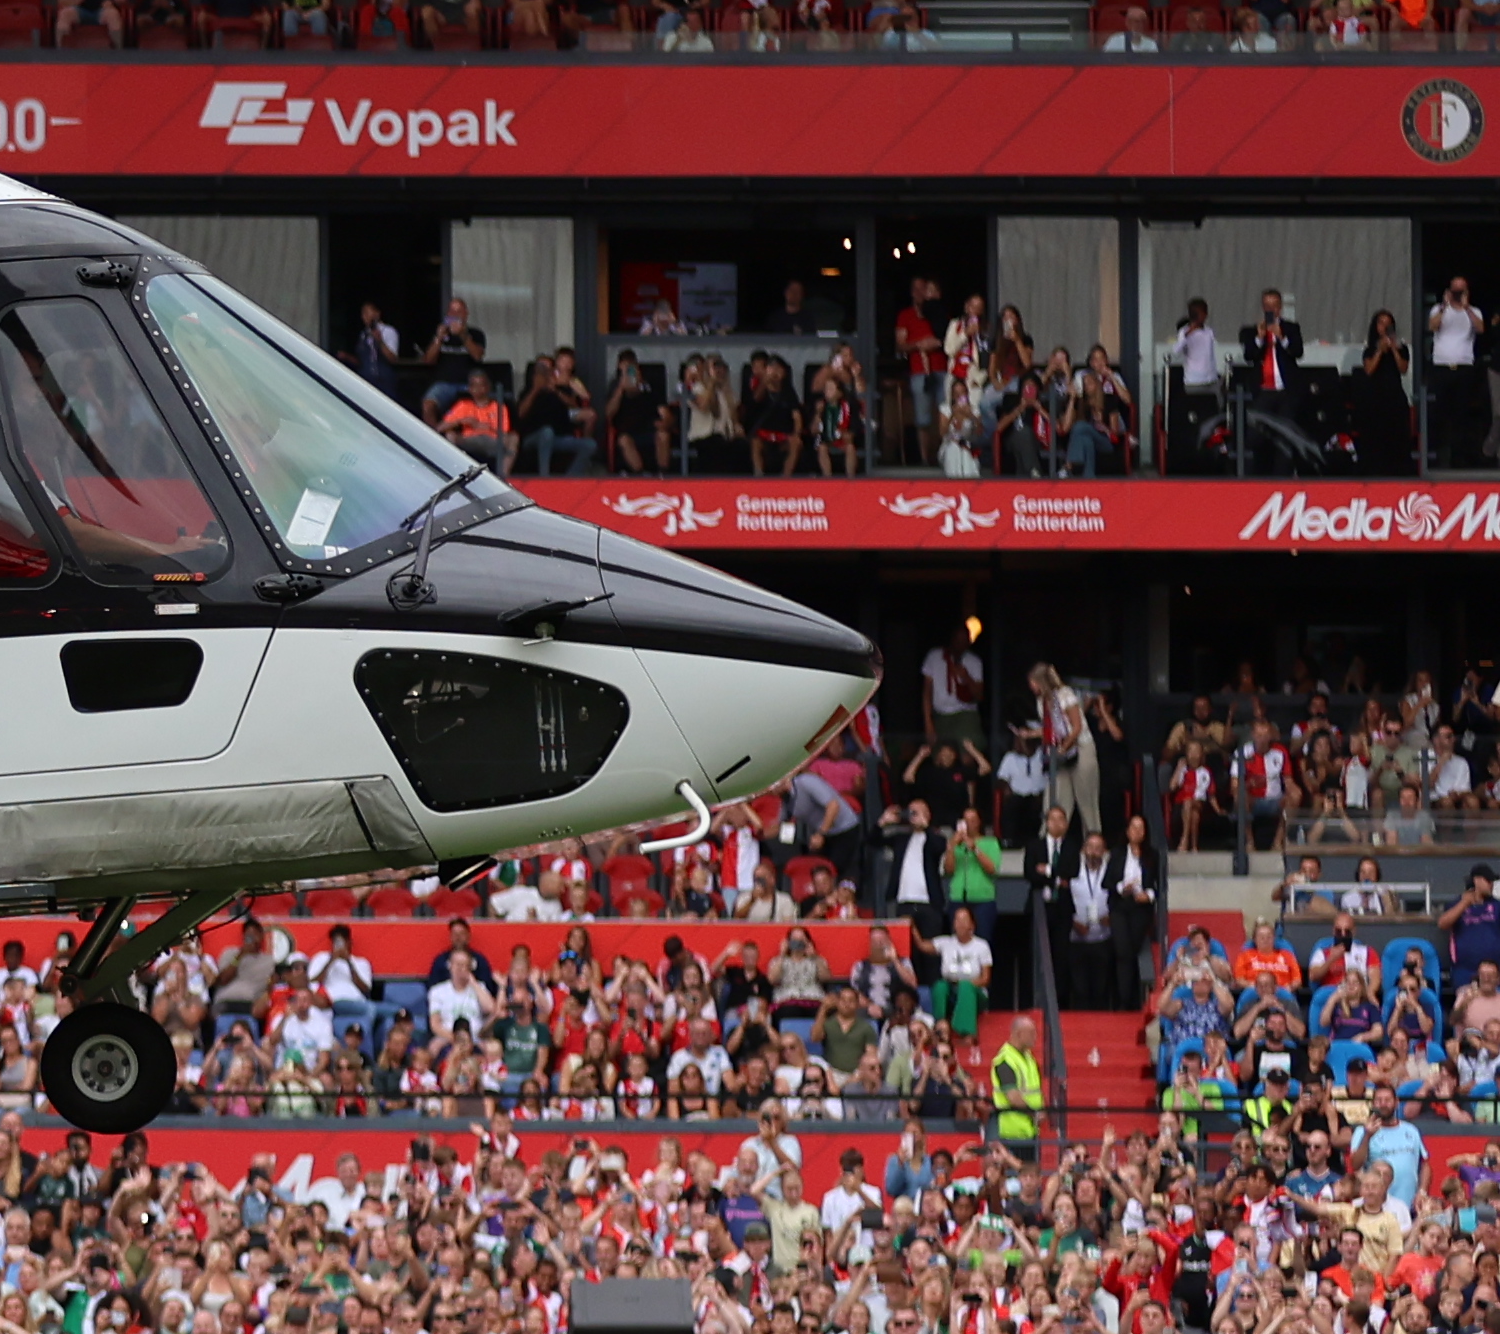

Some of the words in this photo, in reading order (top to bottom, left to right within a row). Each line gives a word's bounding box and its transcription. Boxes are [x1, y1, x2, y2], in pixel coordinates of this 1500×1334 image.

[325, 99, 518, 157] Vopak
[736, 494, 825, 513] Gemeente
[1013, 495, 1101, 514] Gemeente
[737, 512, 828, 531] Rotterdam
[1013, 513, 1104, 532] Rotterdam
